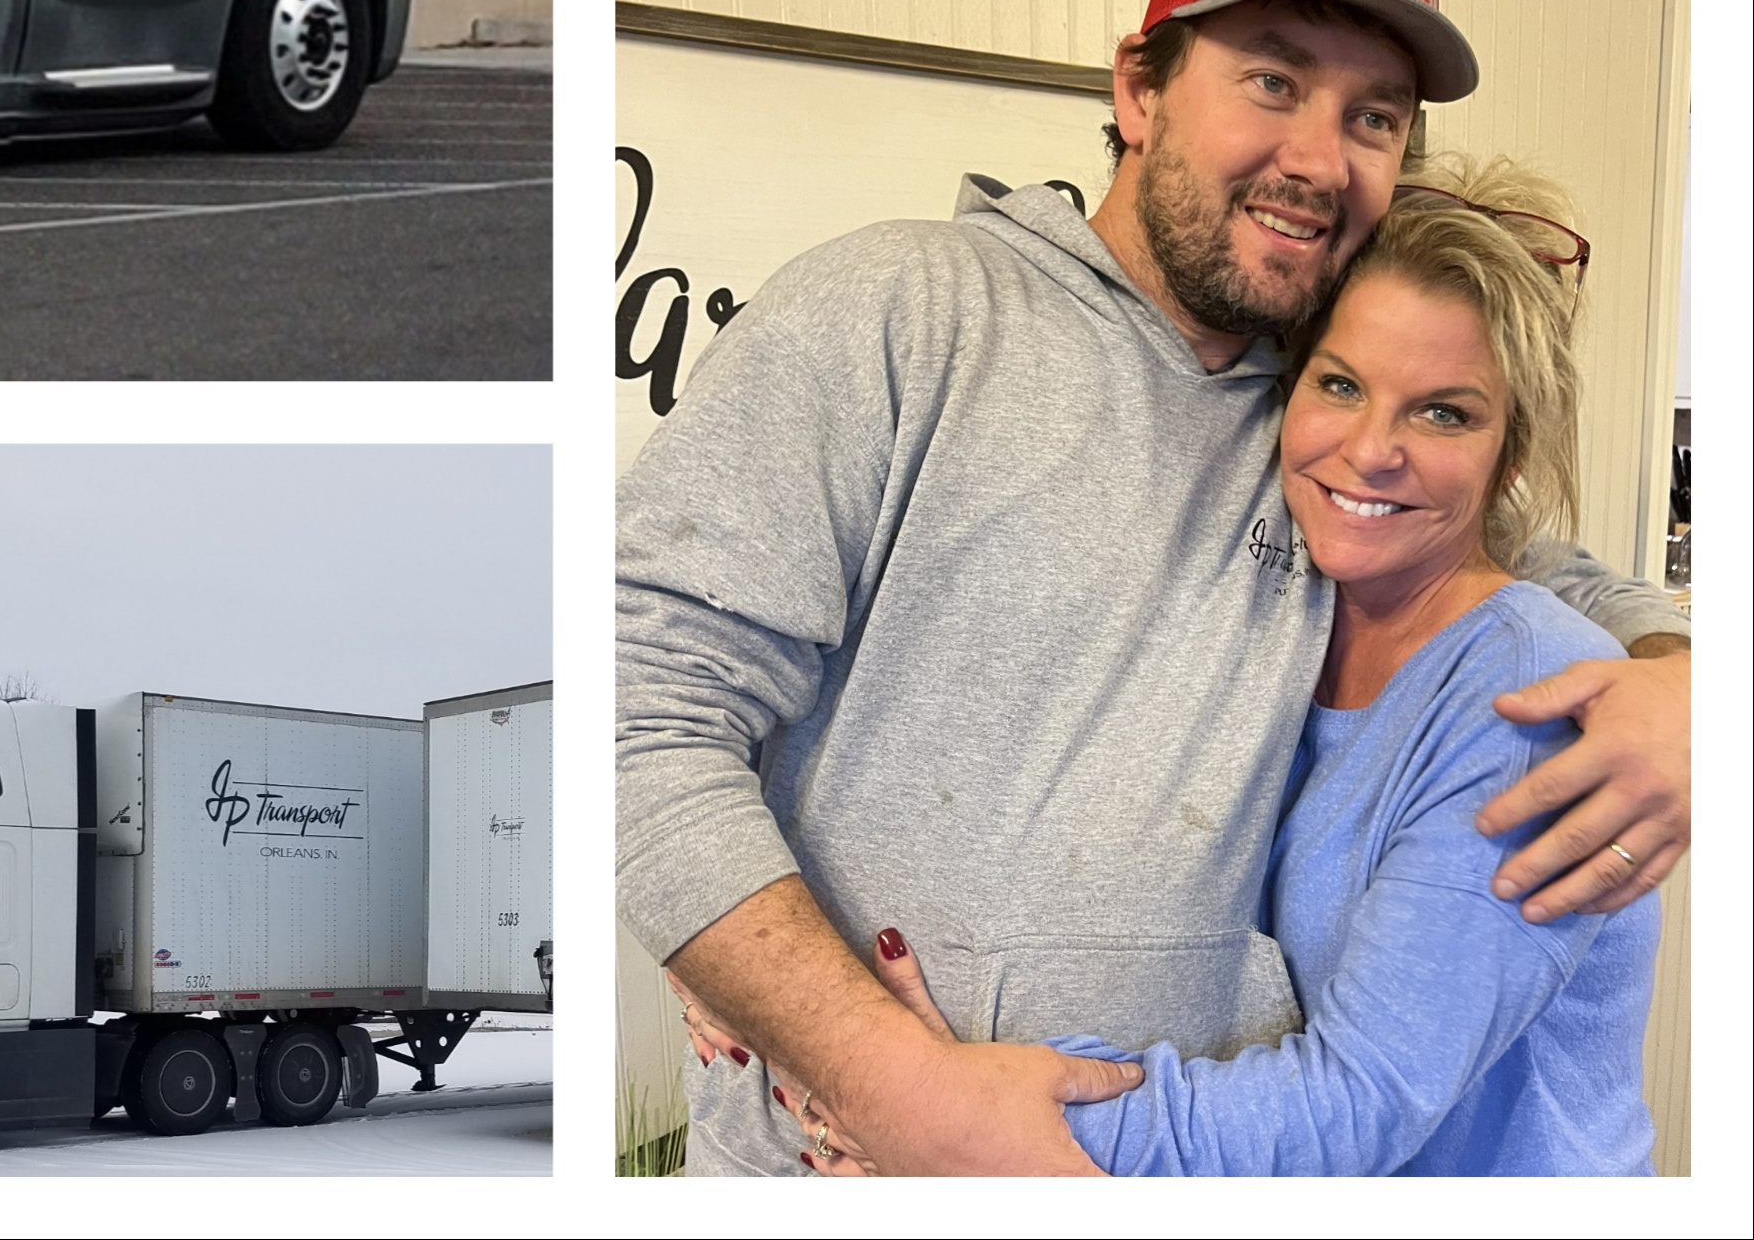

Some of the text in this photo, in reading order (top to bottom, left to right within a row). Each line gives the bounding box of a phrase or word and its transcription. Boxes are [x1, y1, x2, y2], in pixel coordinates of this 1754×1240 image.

[255, 791, 361, 838] Transport
[497, 912, 520, 927] 5303
[185, 974, 212, 989] 5302
